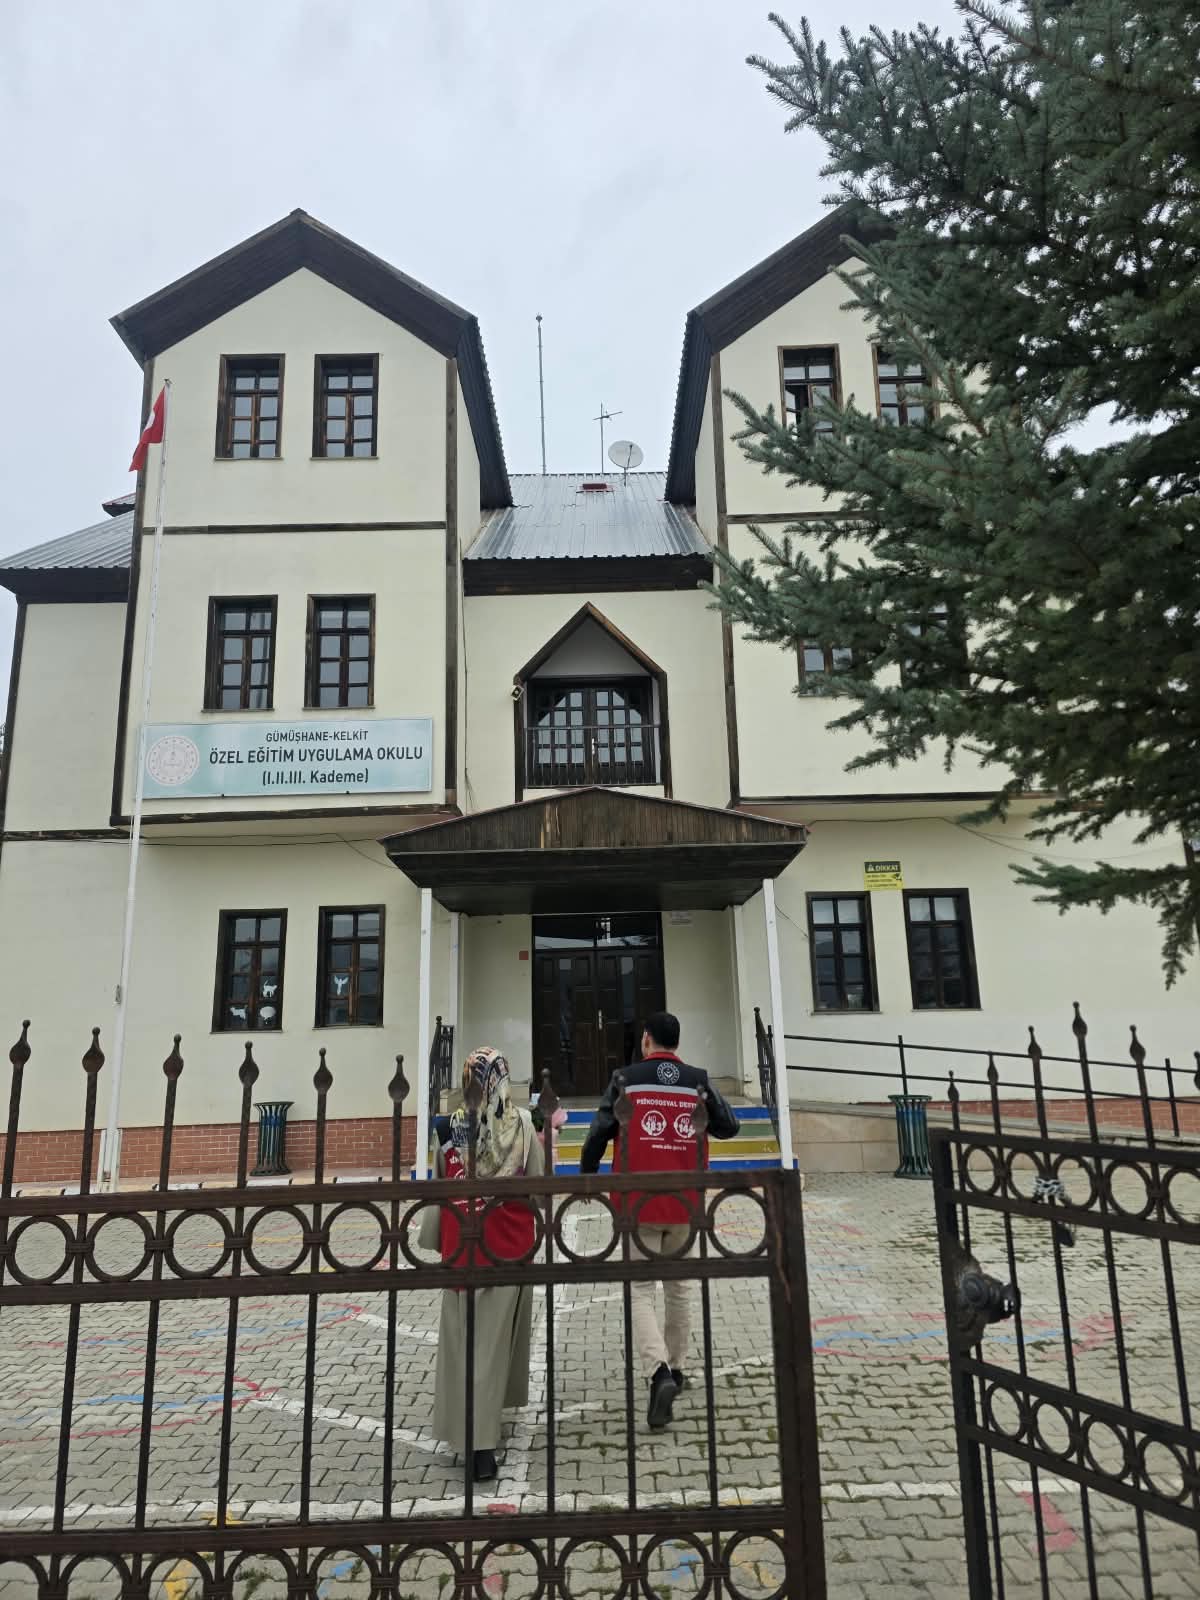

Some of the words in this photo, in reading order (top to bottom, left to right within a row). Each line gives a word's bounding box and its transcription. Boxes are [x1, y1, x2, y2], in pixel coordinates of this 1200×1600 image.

[266, 729, 368, 744] GÜMÜŞHANE-KELKİT
[209, 747, 244, 764] ÖZEL
[247, 746, 294, 763] EĞİTİM
[298, 747, 373, 762] UYGULAMA
[377, 746, 423, 760] OKULU
[262, 770, 306, 786] (I.II.III.
[310, 767, 369, 783] Kademe)
